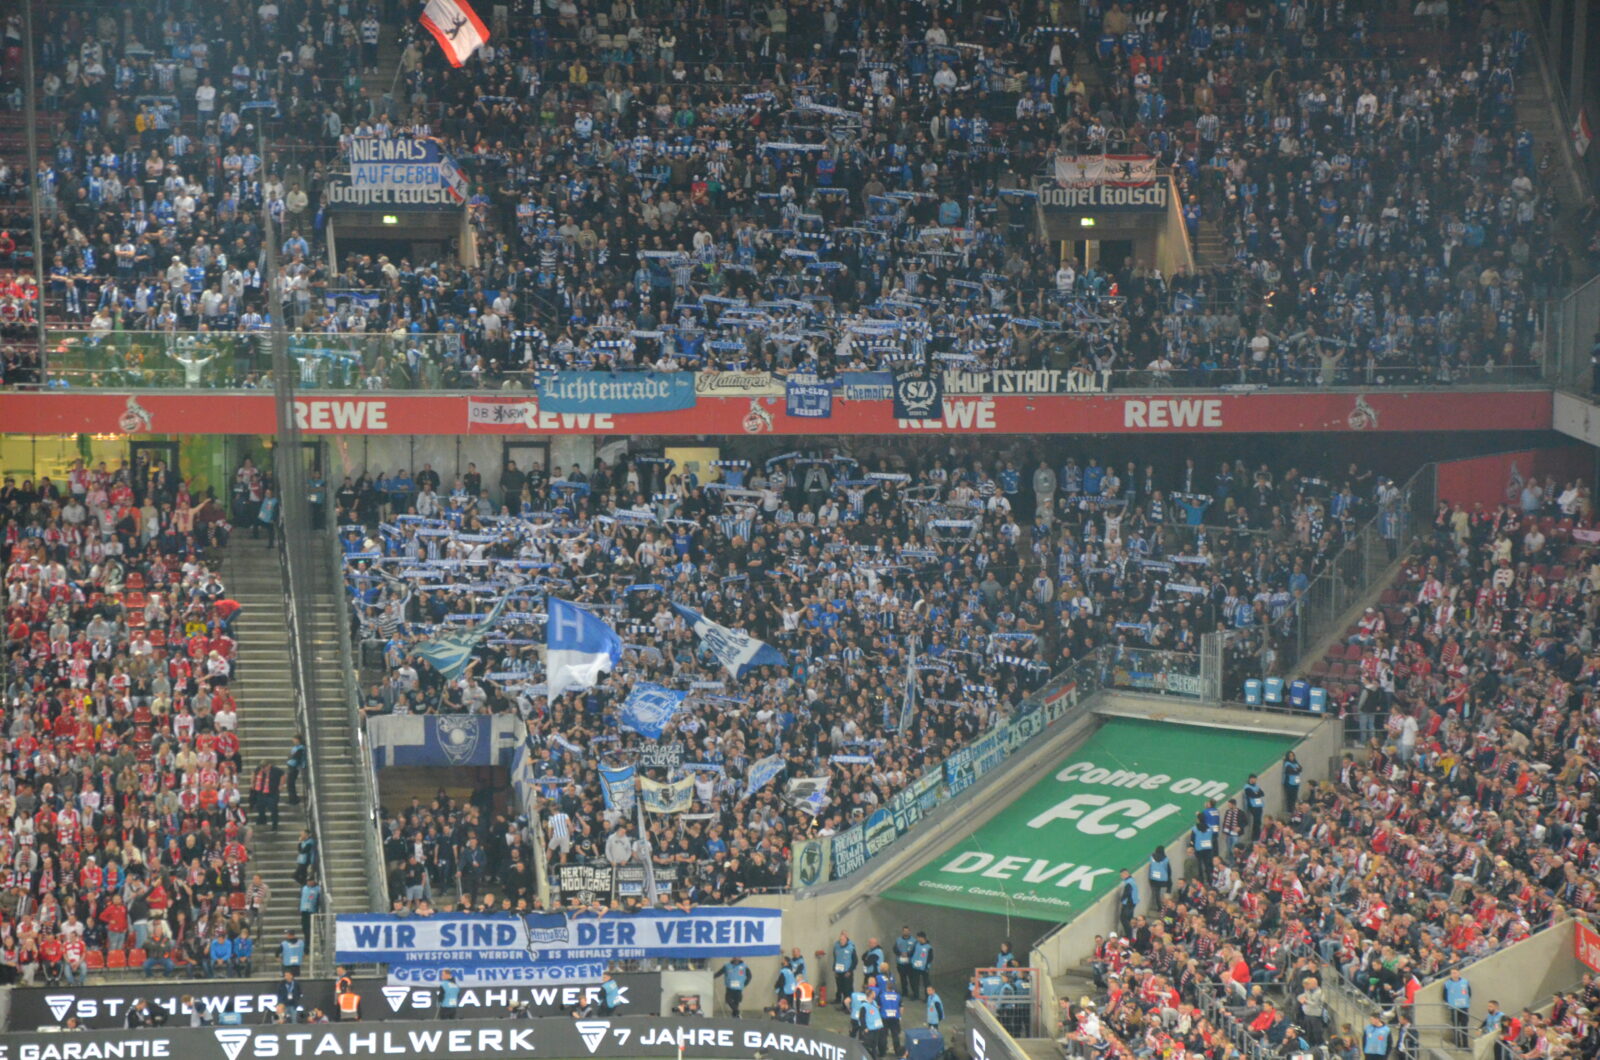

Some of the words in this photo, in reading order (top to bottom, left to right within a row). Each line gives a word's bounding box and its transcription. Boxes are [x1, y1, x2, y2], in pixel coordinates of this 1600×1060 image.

[352, 139, 426, 161] NIEMALS
[355, 164, 440, 185] AUFGEBEN
[541, 376, 671, 403] Lichtenrade
[286, 401, 388, 429] REWE
[1124, 400, 1223, 428] REWE
[1055, 761, 1171, 790] Come
[1026, 793, 1182, 840] FC!
[561, 878, 612, 892] HOOLIGANS
[940, 851, 1115, 892] DEVK
[353, 924, 416, 949] WIR
[439, 922, 517, 948] SIND
[577, 921, 636, 947] DER
[655, 919, 765, 946] VEREIN
[405, 951, 472, 961] INVESTOREN
[478, 950, 523, 960] WERDEN
[548, 950, 562, 960] ES
[567, 948, 613, 959] NIEMALS
[477, 964, 603, 982] INVESTOREN
[20, 1039, 170, 1060] GARANTIE
[253, 1028, 535, 1058] STAHLWERK
[613, 1028, 632, 1046] 7
[640, 1028, 734, 1047] JAHRE
